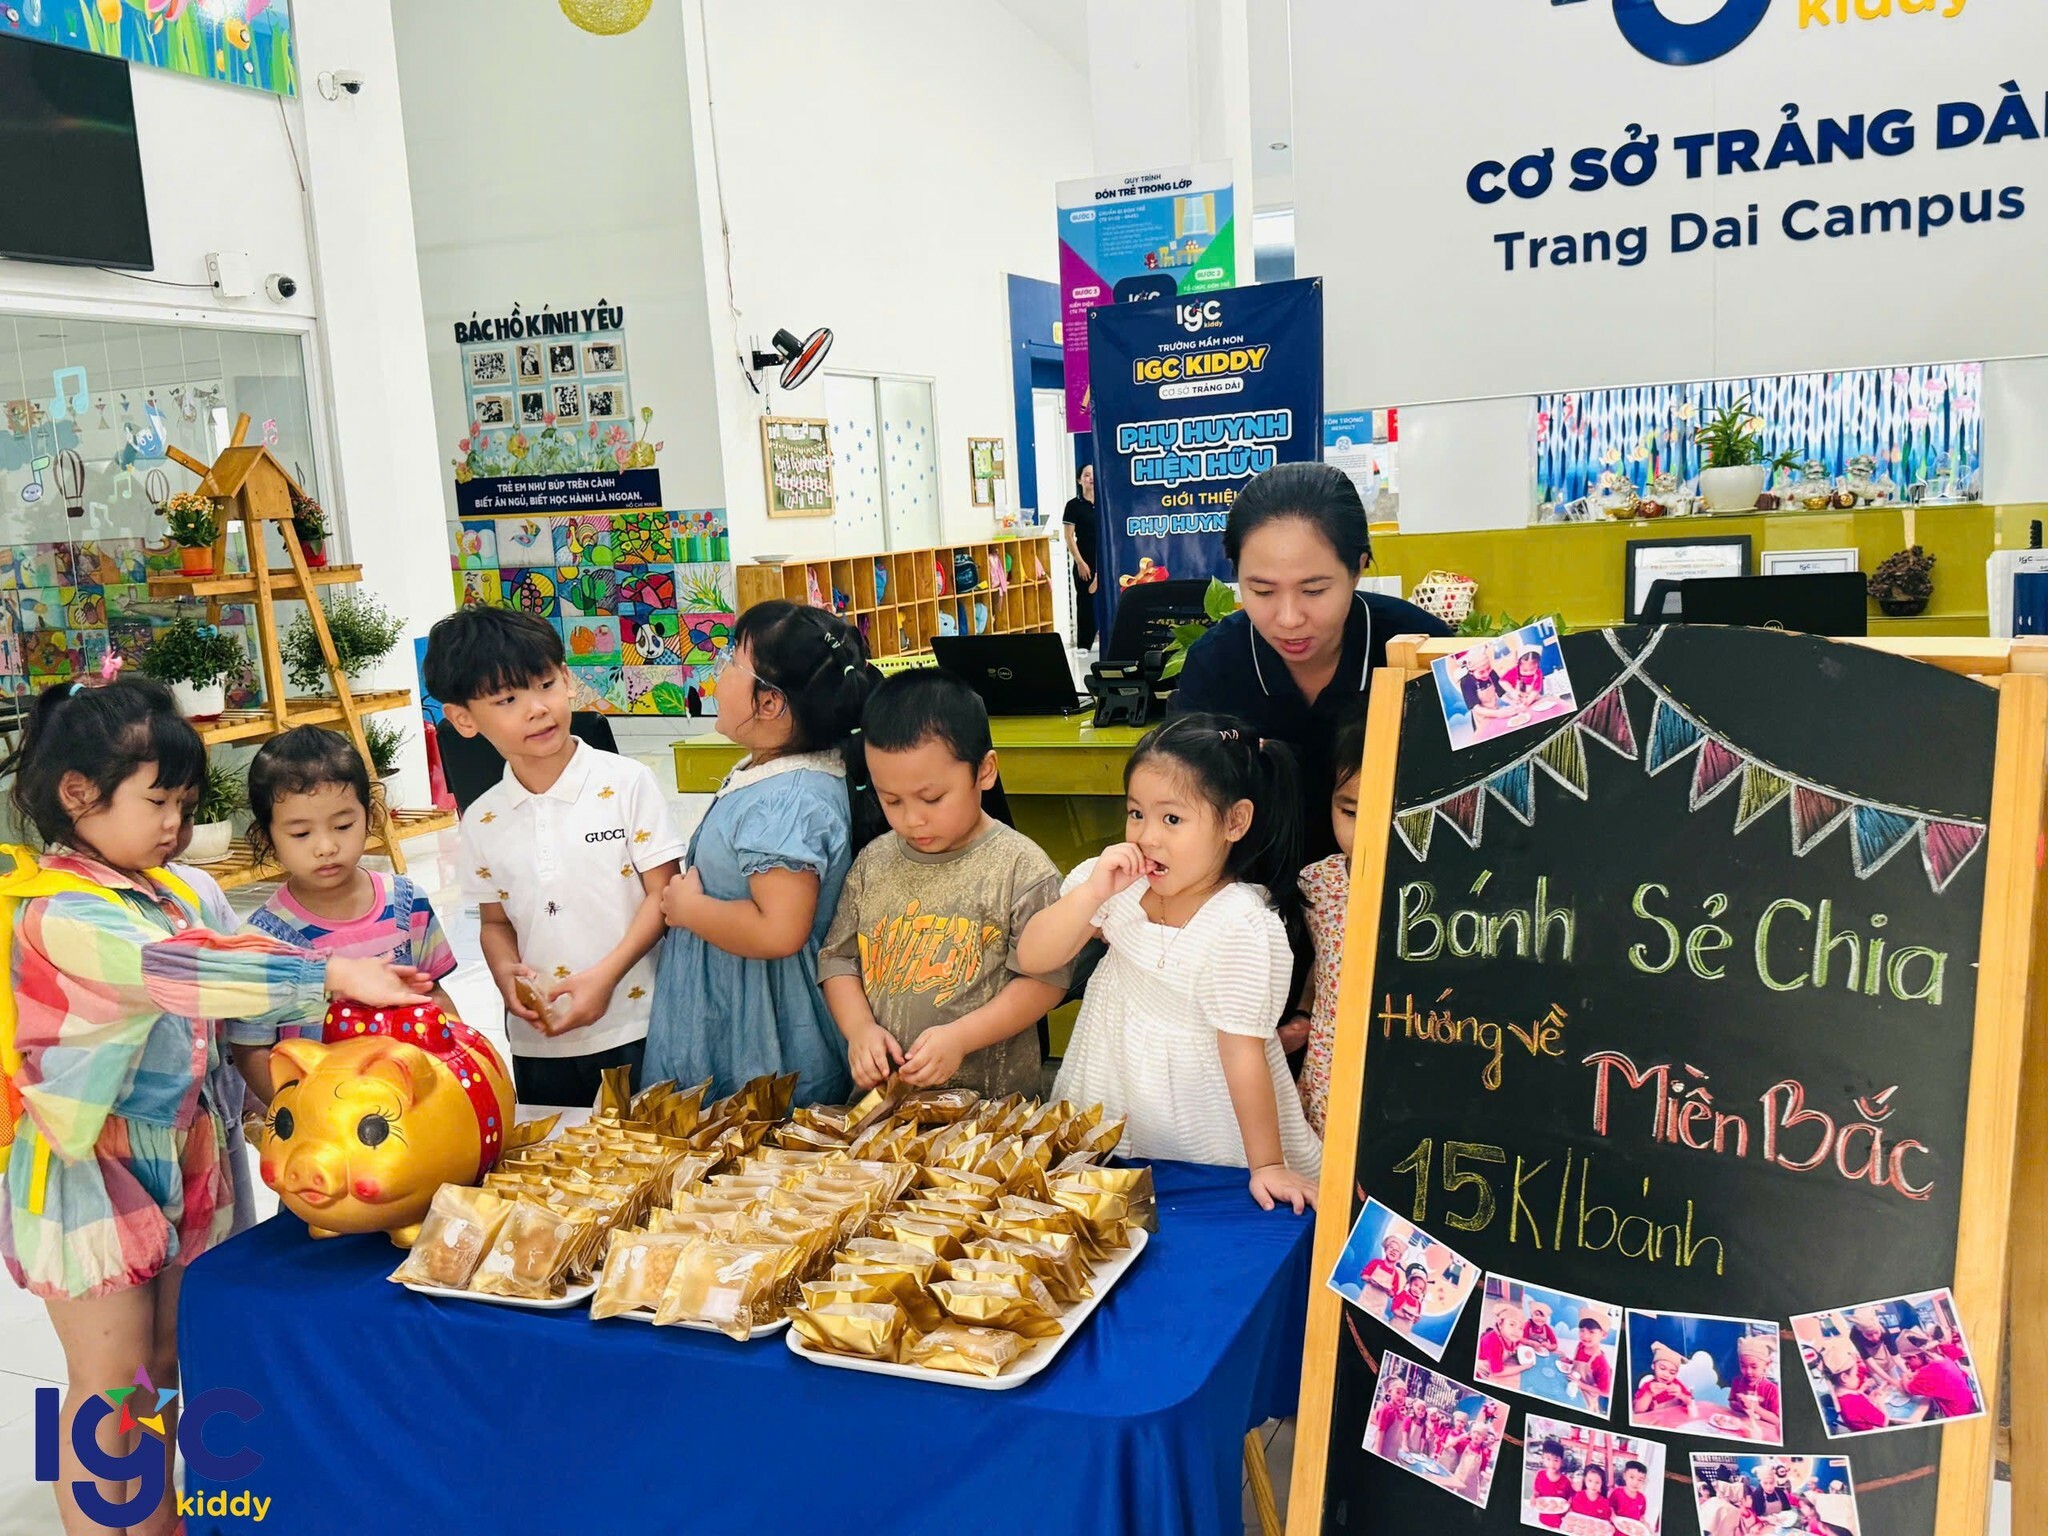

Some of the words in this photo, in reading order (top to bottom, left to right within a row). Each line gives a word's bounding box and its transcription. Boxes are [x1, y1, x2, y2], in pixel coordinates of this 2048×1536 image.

[1466, 147, 1554, 205] CƠ
[1568, 123, 1660, 193] SỞ
[1674, 103, 1915, 180] TRẢNG
[1936, 79, 2048, 150] DÀ
[1138, 183, 1172, 195] TRONG
[1173, 179, 1193, 190] LỚP
[1494, 225, 1648, 272] Trang
[1670, 203, 1758, 253] Dai
[1782, 184, 2025, 242] Campus
[454, 311, 494, 343] BÁC
[495, 301, 524, 340] HỒ
[525, 303, 579, 337] KÍNH
[581, 298, 623, 331] YÊU
[1203, 319, 1224, 329] kiddy
[1222, 334, 1244, 345] NON
[1136, 358, 1181, 382] IGC
[1185, 347, 1267, 376] KIDDY
[1120, 423, 1178, 452] PHỤ
[1184, 414, 1288, 445] HUYNH
[1135, 453, 1200, 484] HIỆN
[1207, 447, 1273, 477] HỮU
[475, 498, 493, 508] BIẾT
[494, 496, 507, 507] ĂN
[530, 494, 548, 505] BIẾT
[550, 495, 568, 506] HỌC
[569, 492, 594, 503] HÀNH
[595, 491, 608, 503] LÀ
[609, 491, 642, 502] NGOAN.
[497, 482, 513, 493] TRẺ
[515, 482, 526, 492] EM
[528, 480, 547, 492] NHƯ
[548, 479, 565, 490] BÚP
[567, 478, 590, 490] TRÊN
[591, 477, 615, 489] CÀNH
[1161, 491, 1194, 507] GIỚI
[1128, 517, 1169, 536] PHỤ
[585, 829, 625, 843] GUCCI
[1398, 869, 1574, 964] Bánh
[1628, 882, 1733, 980] Sẻ
[1756, 898, 1947, 1005] Chia
[1377, 987, 1503, 1090] Hướng
[1507, 1002, 1568, 1057] về
[1582, 1050, 1748, 1158] Miền
[1759, 1078, 1935, 1200] Bắc
